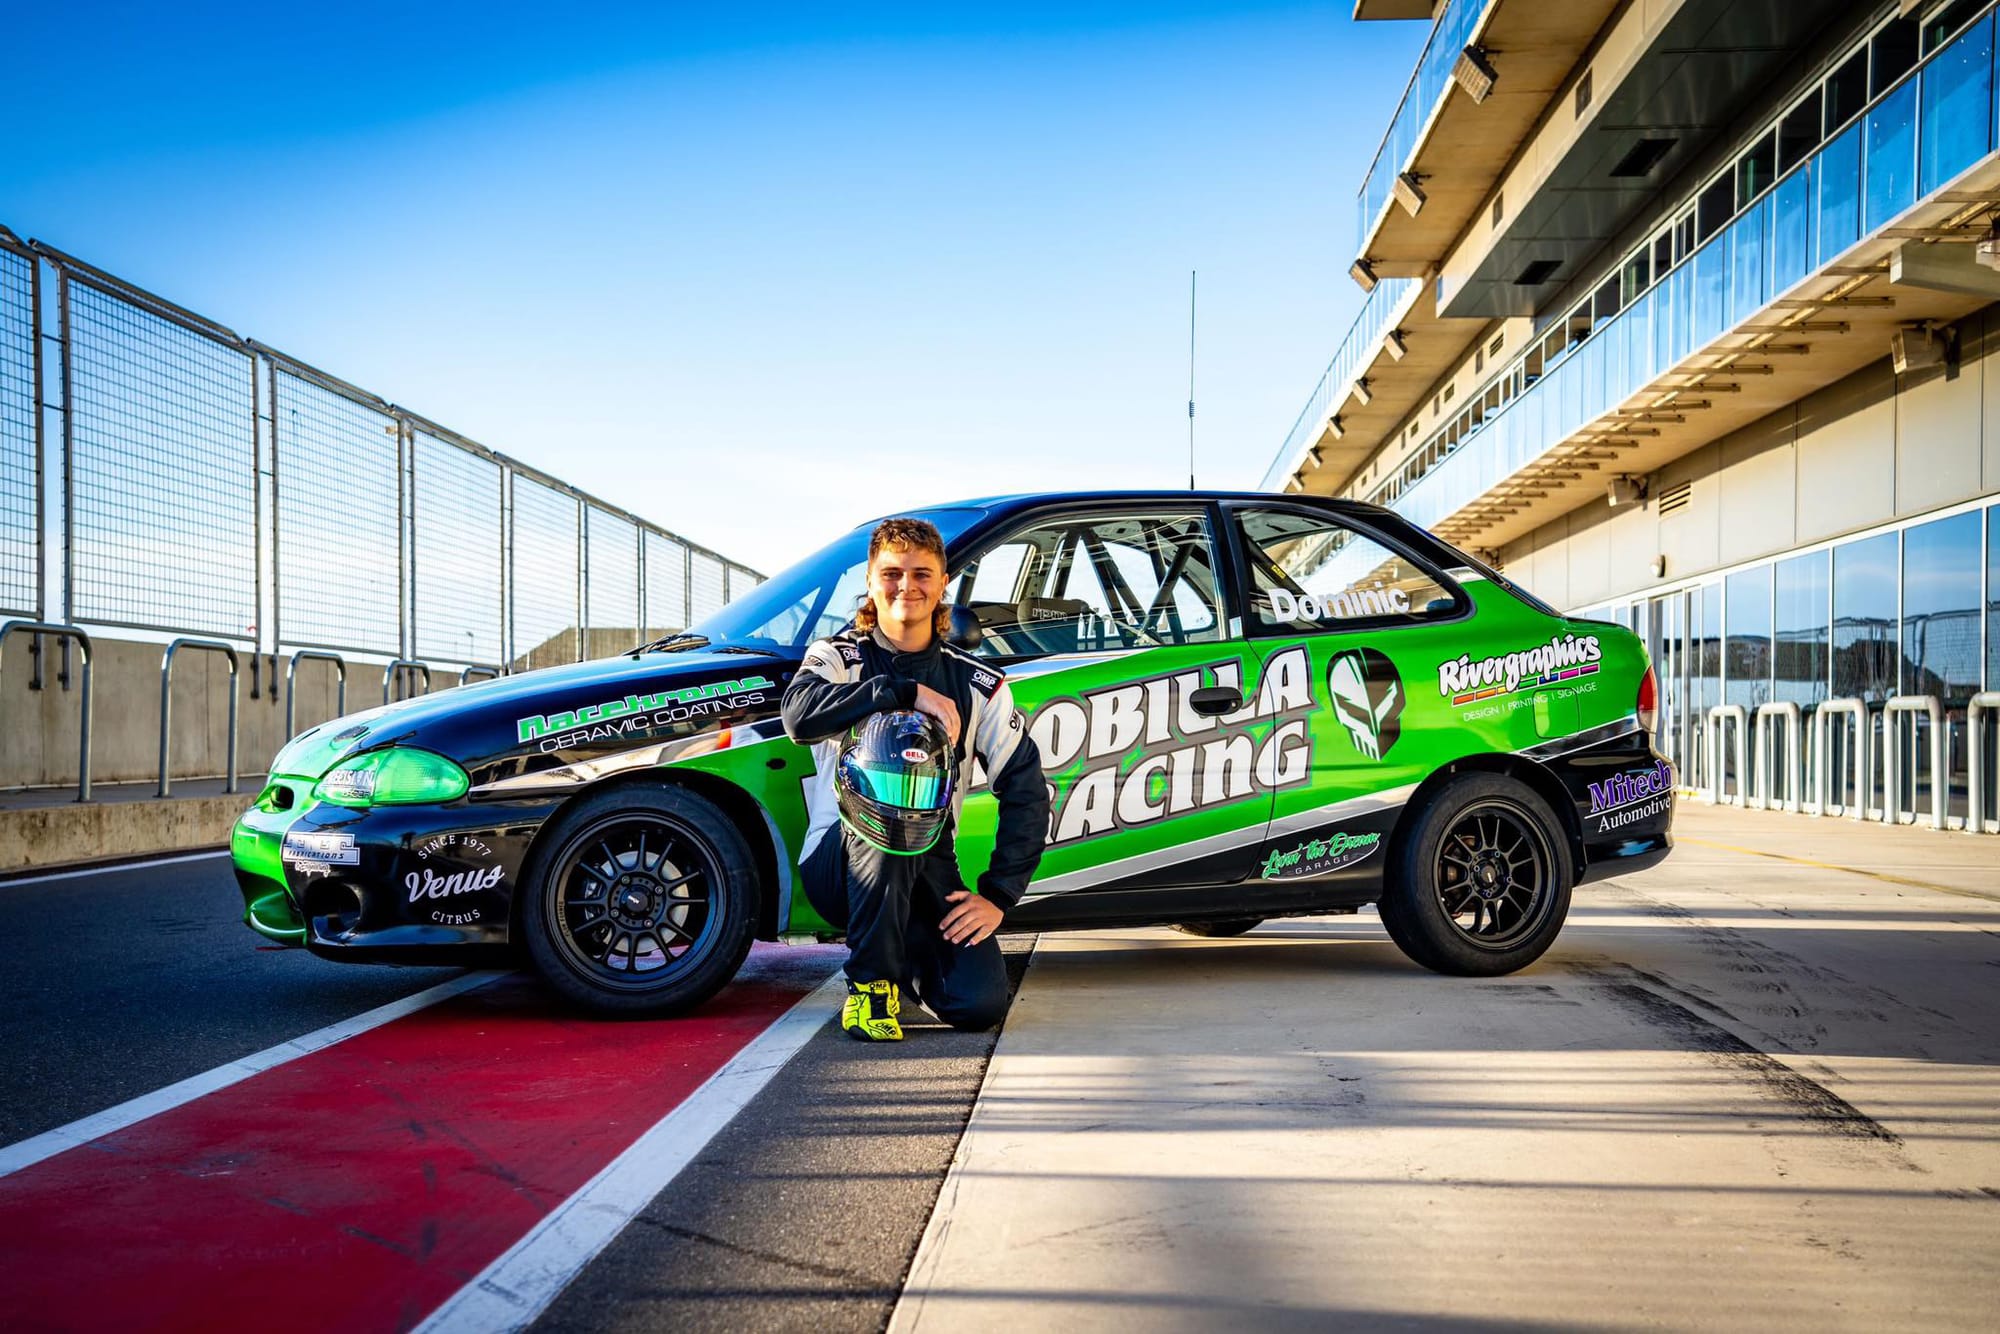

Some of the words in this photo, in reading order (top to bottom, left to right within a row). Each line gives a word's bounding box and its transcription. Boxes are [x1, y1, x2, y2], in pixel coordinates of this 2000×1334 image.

[1268, 581, 1410, 622] Dominic
[973, 671, 996, 687] OMP
[1438, 634, 1602, 696] Rivergraphics
[1463, 706, 1499, 722] DESIGN
[1508, 694, 1548, 712] PRINTING
[1557, 682, 1598, 699] SIGNAGE
[539, 715, 650, 754] CERAMIC
[654, 692, 766, 725] COATINGS
[905, 750, 925, 759] BELL
[1044, 720, 1310, 844] ACING
[1587, 758, 1673, 813] Mitech
[1598, 796, 1672, 833] Automotive
[418, 835, 456, 860] SINCE
[462, 836, 492, 856] 1977
[1295, 854, 1350, 875] GARAGE
[1306, 839, 1329, 861] the
[1328, 832, 1381, 857] Dream
[405, 864, 505, 902] Venus
[431, 908, 481, 925] CITRUS
